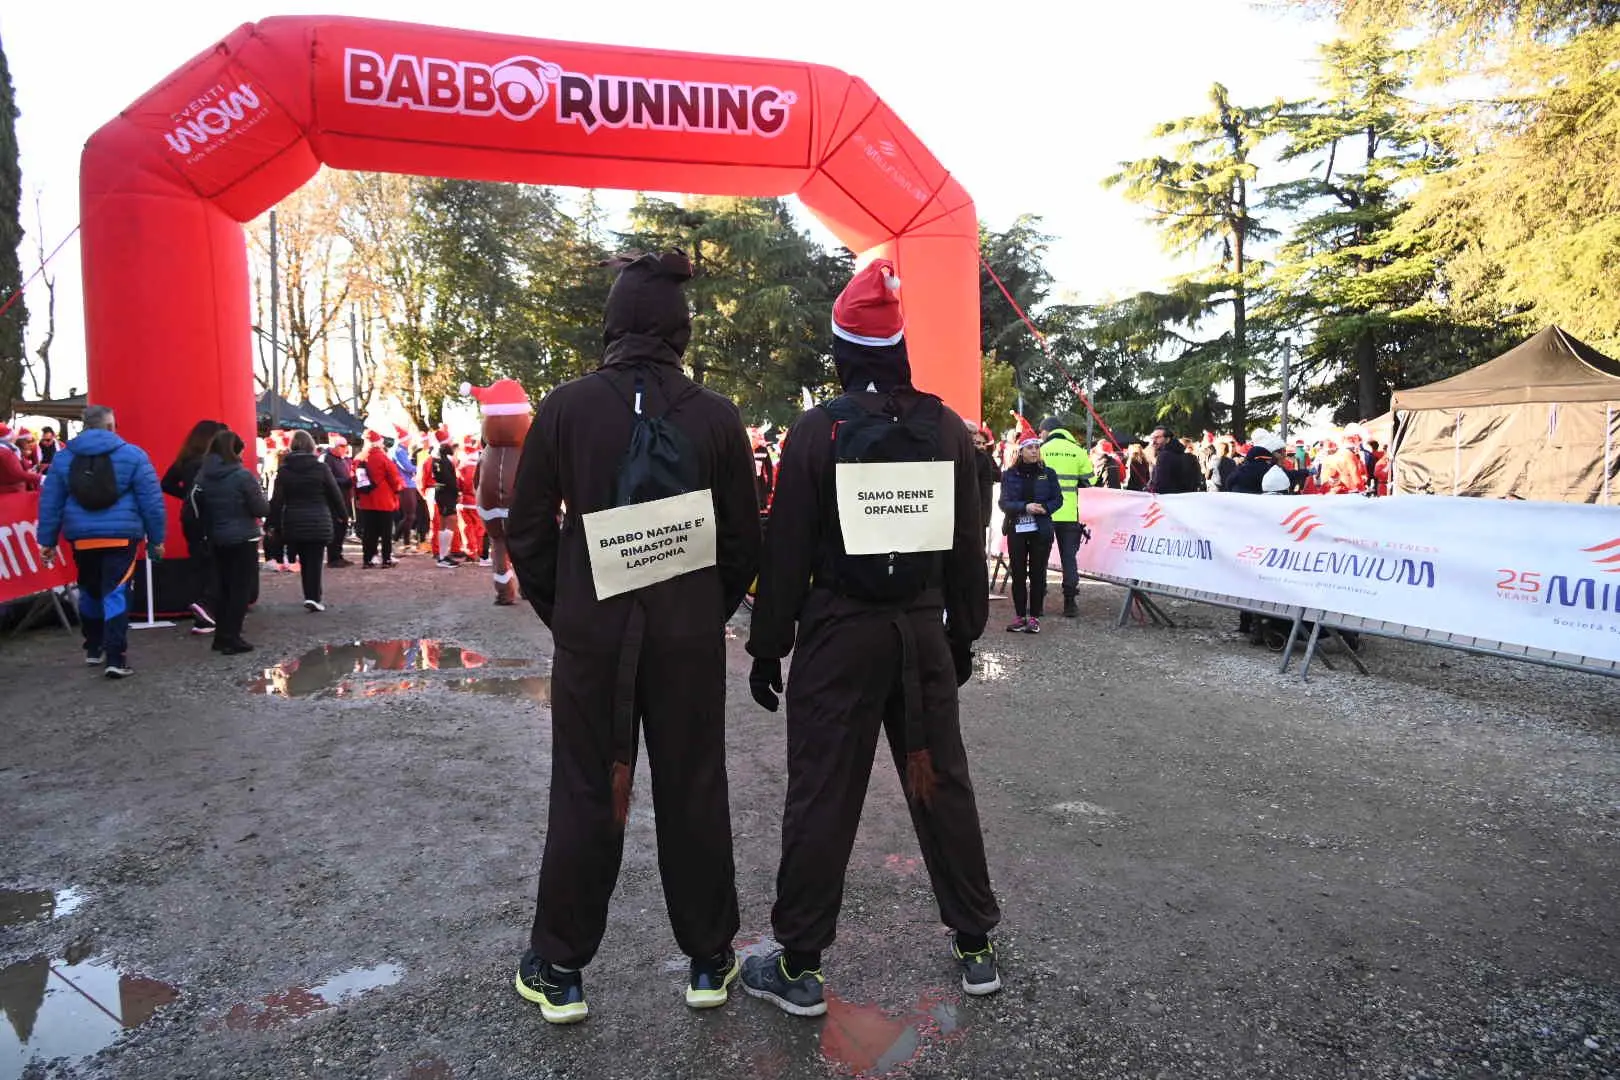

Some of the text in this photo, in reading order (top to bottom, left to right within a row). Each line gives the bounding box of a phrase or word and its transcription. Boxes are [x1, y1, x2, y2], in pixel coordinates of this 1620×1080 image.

[344, 50, 788, 136] BABBO RUNNING
[164, 84, 260, 155] WOW
[857, 489, 934, 501] SIAMO RENNE
[864, 504, 929, 515] ORFANELLE
[600, 531, 643, 548] BABBO
[646, 520, 692, 539] NATALE
[620, 534, 688, 558] RIMASTO IN
[626, 546, 686, 569] LAPPONIA
[1237, 545, 1265, 560] 25
[1259, 547, 1435, 588] MILLENNIUM
[1496, 568, 1541, 592] 25
